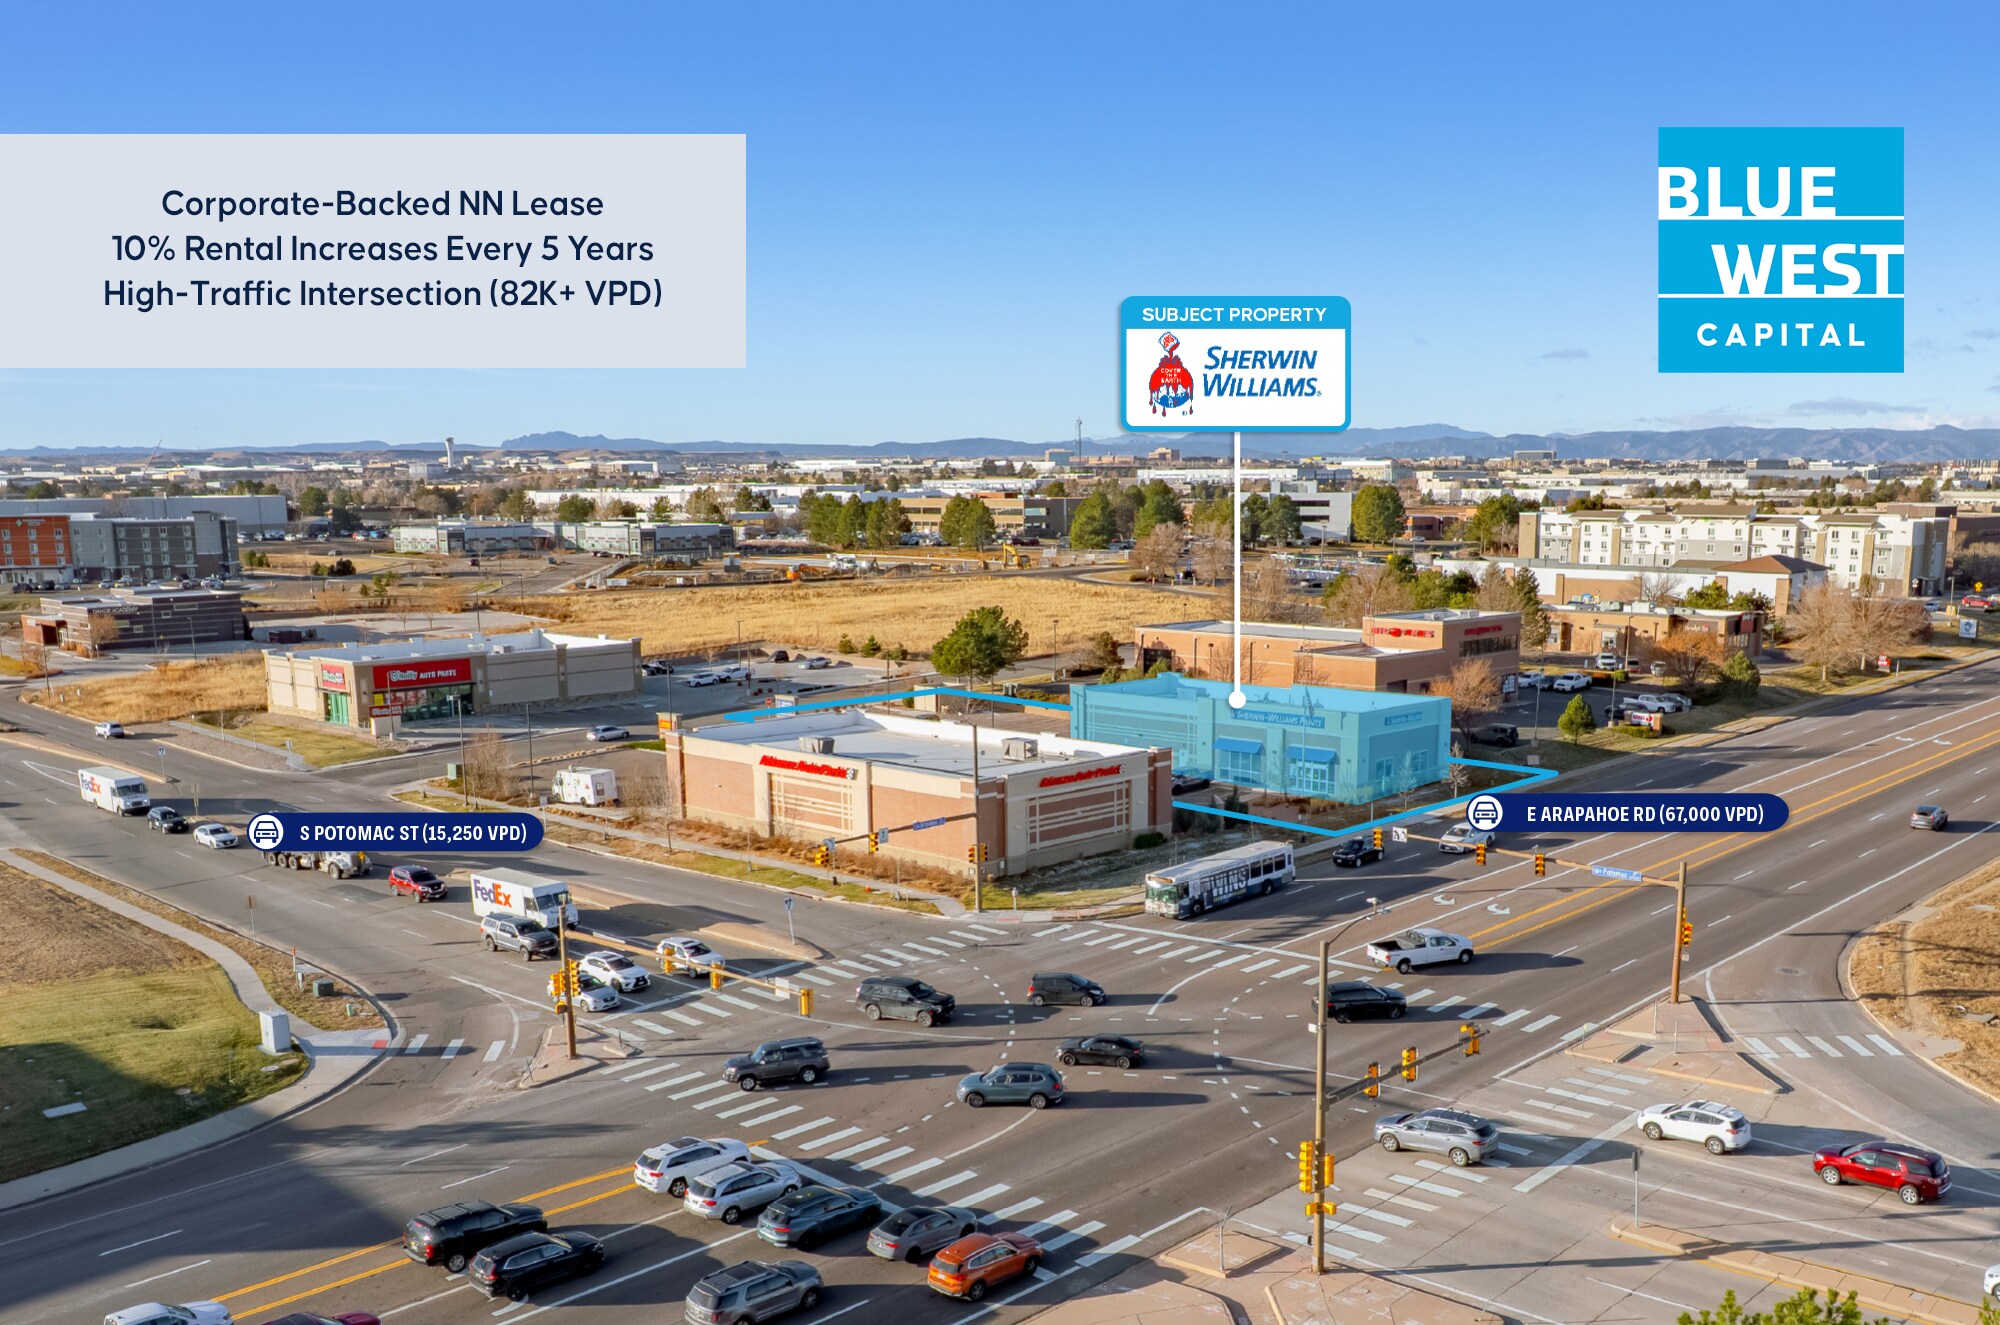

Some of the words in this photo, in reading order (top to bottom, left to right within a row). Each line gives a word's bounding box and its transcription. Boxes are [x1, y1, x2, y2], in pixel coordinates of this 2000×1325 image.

[419, 671, 436, 679] AUTO
[437, 669, 457, 678] PARTS
[81, 773, 101, 794] FedEx
[473, 879, 512, 908] FedEx
